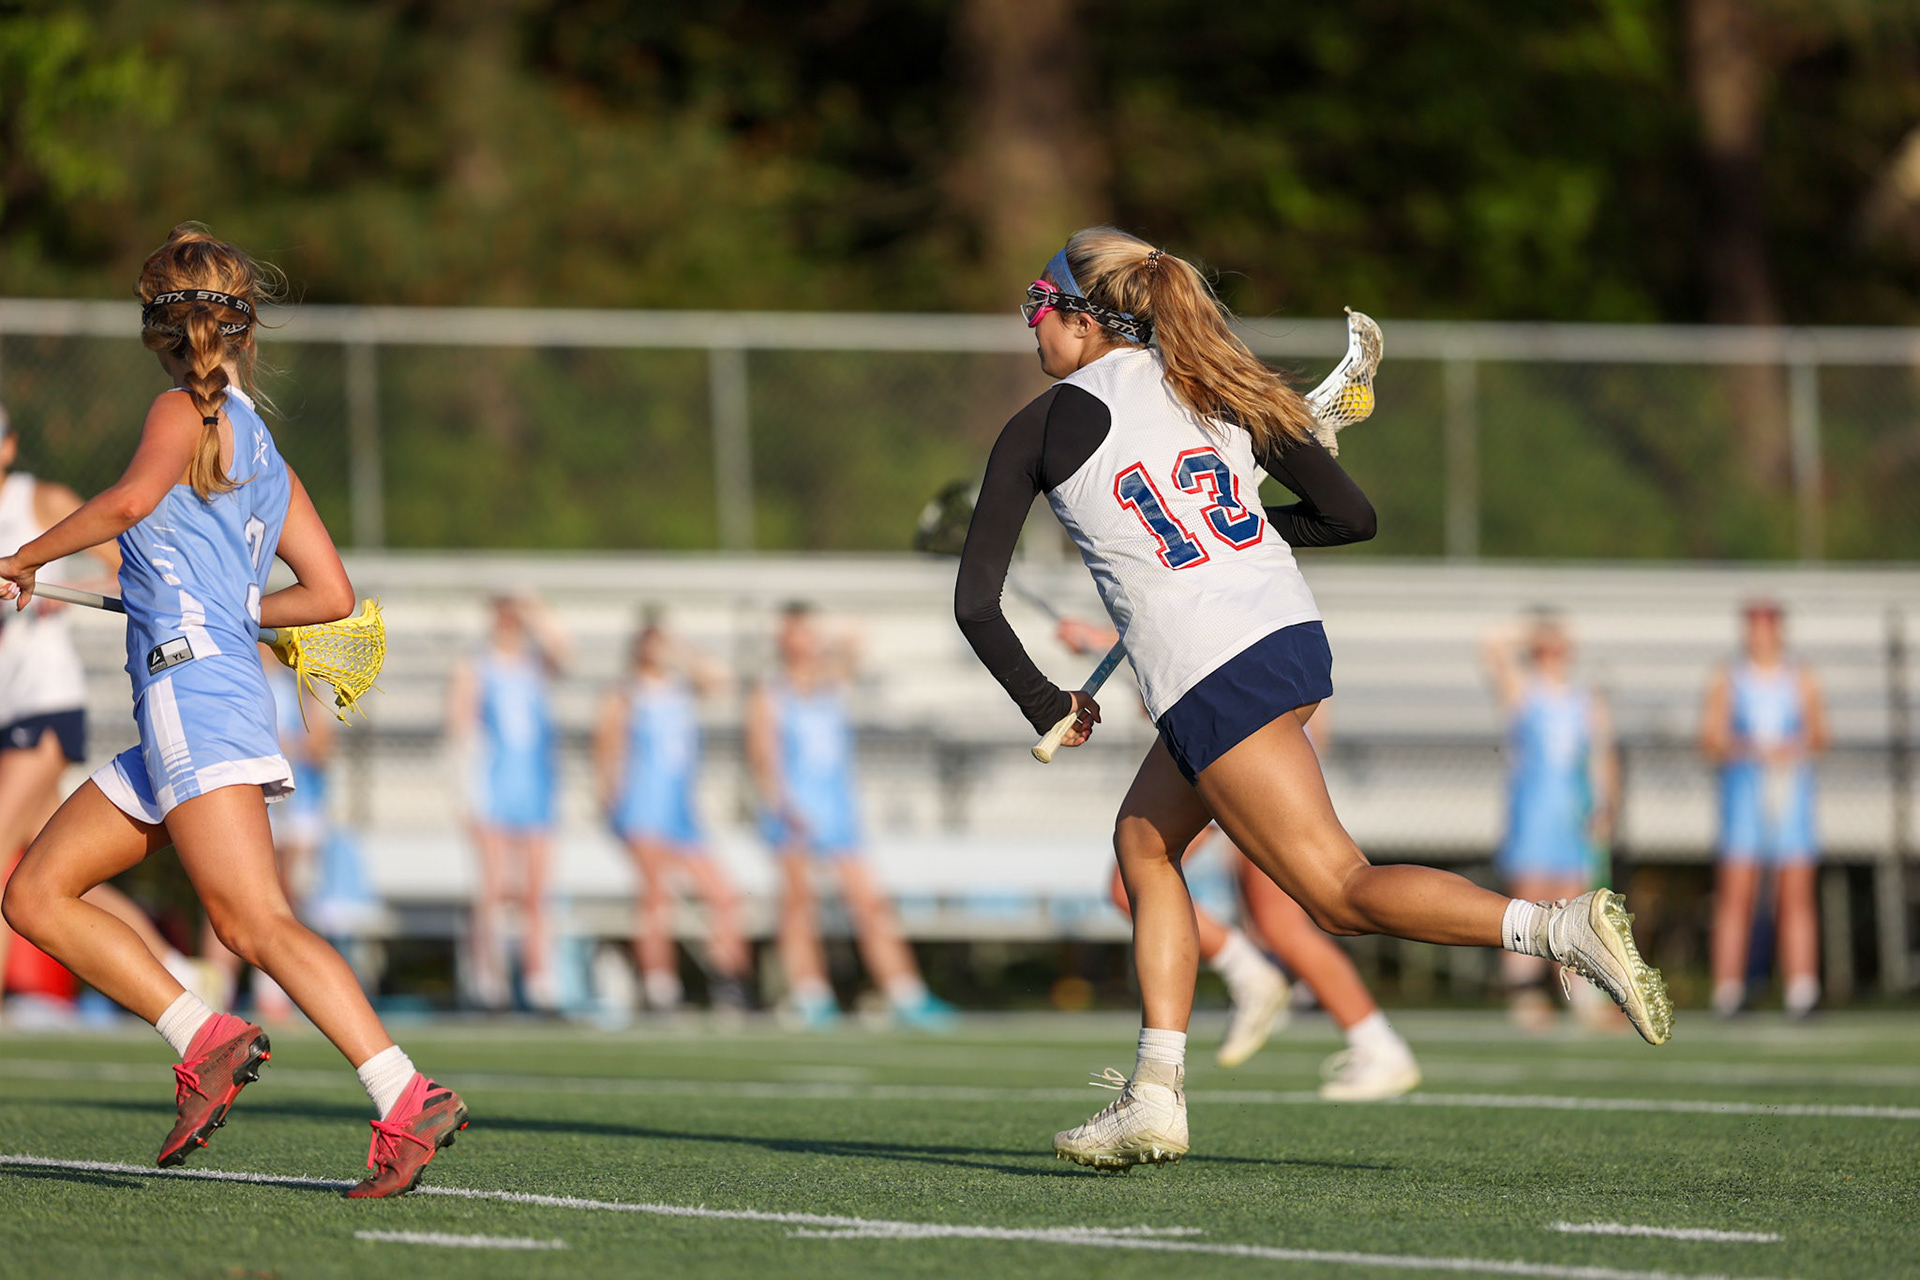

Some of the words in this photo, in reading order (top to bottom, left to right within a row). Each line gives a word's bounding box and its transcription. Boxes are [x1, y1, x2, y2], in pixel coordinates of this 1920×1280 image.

[154, 291, 185, 305] STX
[196, 291, 229, 305] STX
[1107, 319, 1139, 336] STX
[1113, 446, 1265, 571] 13
[172, 652, 185, 661] YL
